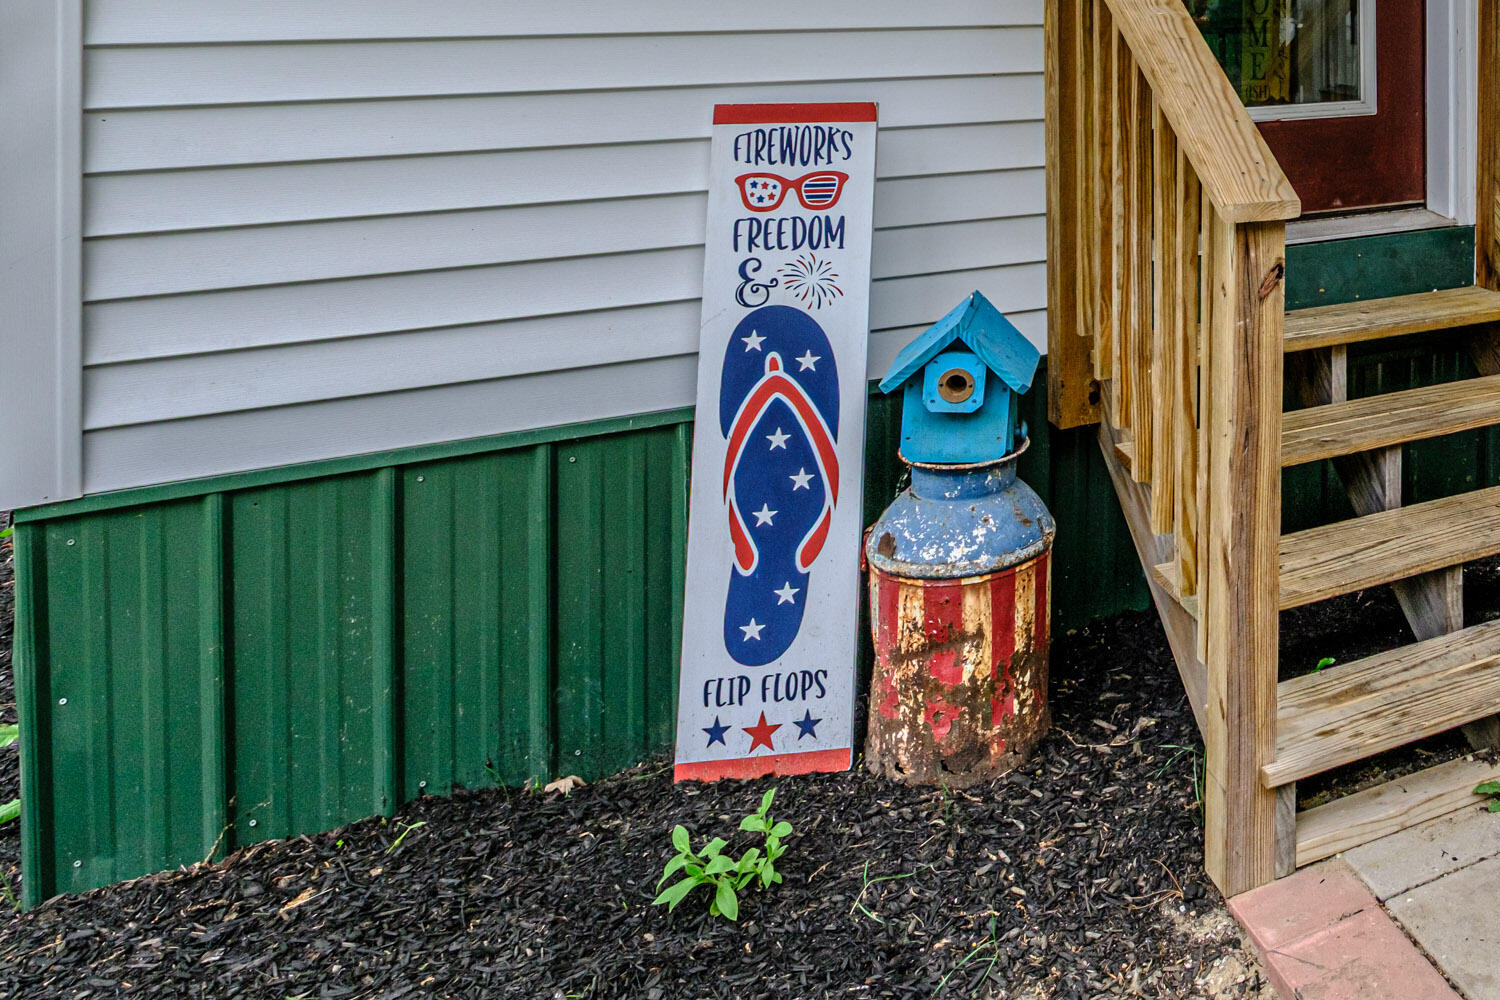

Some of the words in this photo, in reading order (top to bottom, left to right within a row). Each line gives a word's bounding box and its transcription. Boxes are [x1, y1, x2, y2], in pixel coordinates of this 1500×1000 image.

[733, 125, 854, 167] FIREWORKS
[733, 215, 846, 253] FREEDOM
[735, 257, 779, 308] &
[703, 675, 751, 708] FLIP
[761, 669, 828, 703] FLOPS
